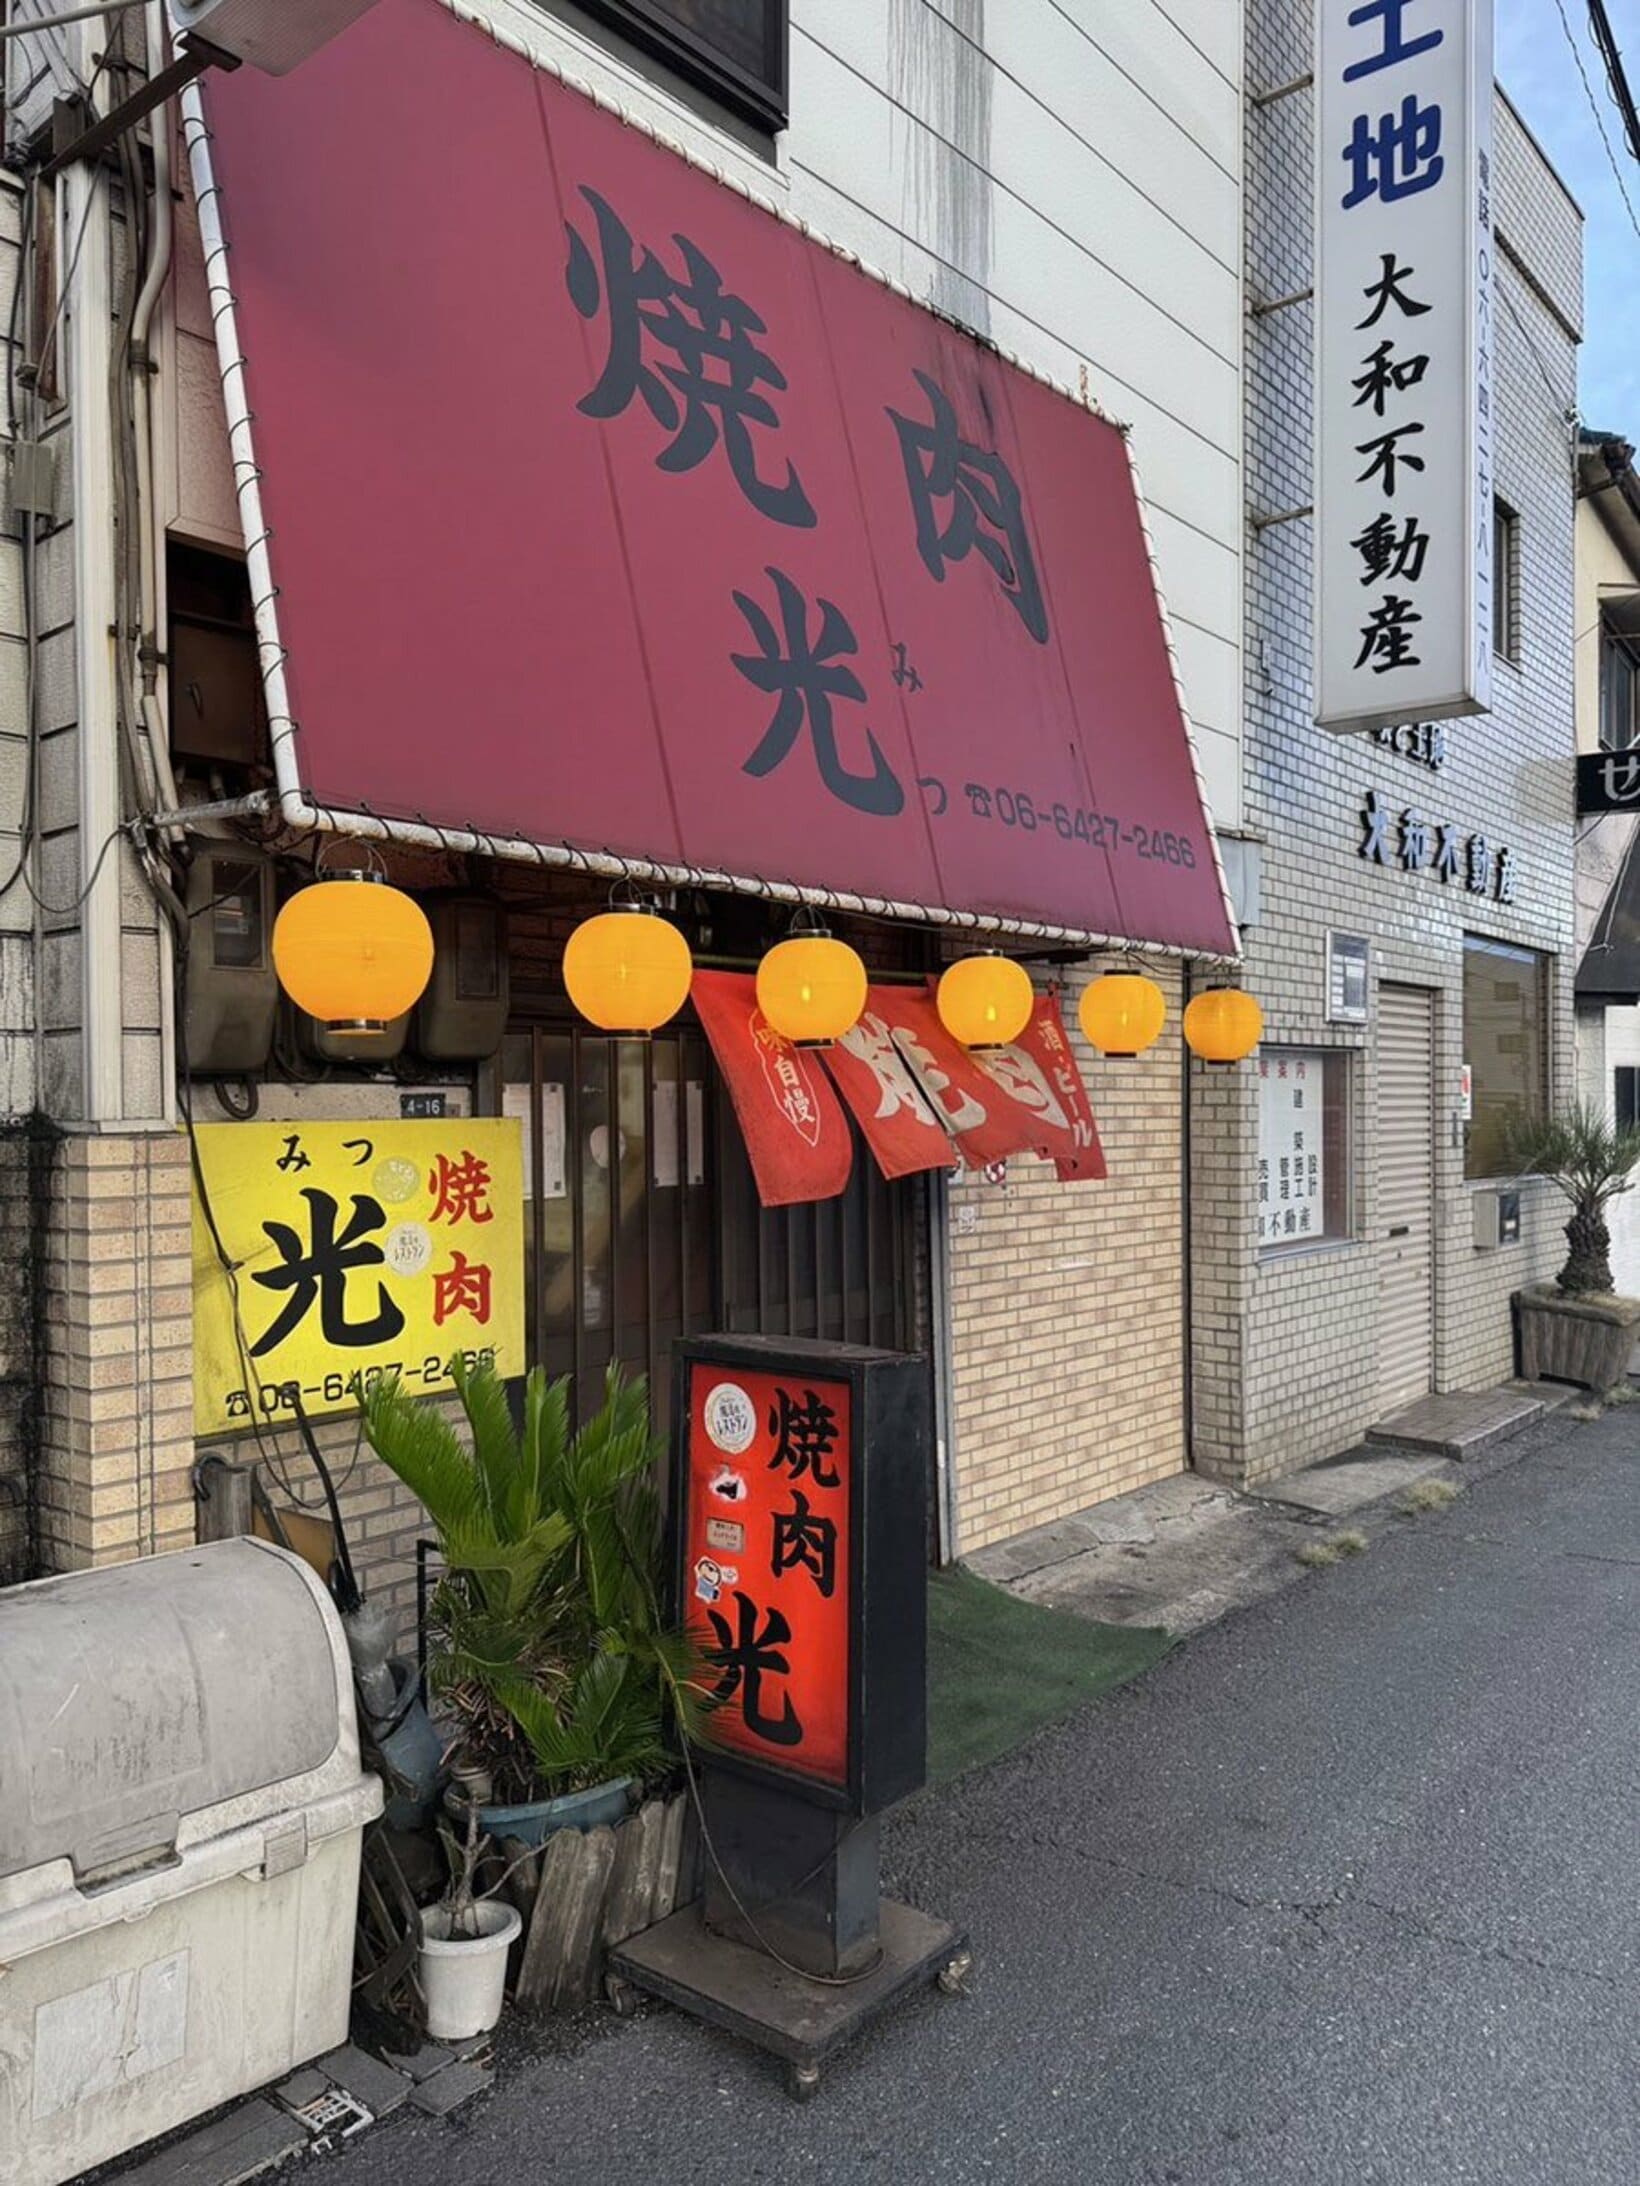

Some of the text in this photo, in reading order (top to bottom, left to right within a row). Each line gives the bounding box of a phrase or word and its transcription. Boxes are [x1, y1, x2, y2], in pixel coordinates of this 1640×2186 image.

[564, 183, 1049, 645] 焼肉
[1350, 253, 1433, 674] 大和不動産
[730, 565, 904, 816] 光
[995, 787, 1197, 869] 06-6427-2466
[1358, 790, 1518, 905] 大和不動産
[275, 1134, 374, 1173] みつ
[407, 1099, 440, 1115] 4-16
[250, 1187, 406, 1358] 光
[427, 1149, 495, 1327] 焼肉
[767, 1387, 842, 1599] 焼肉
[703, 1591, 802, 1746] 光
